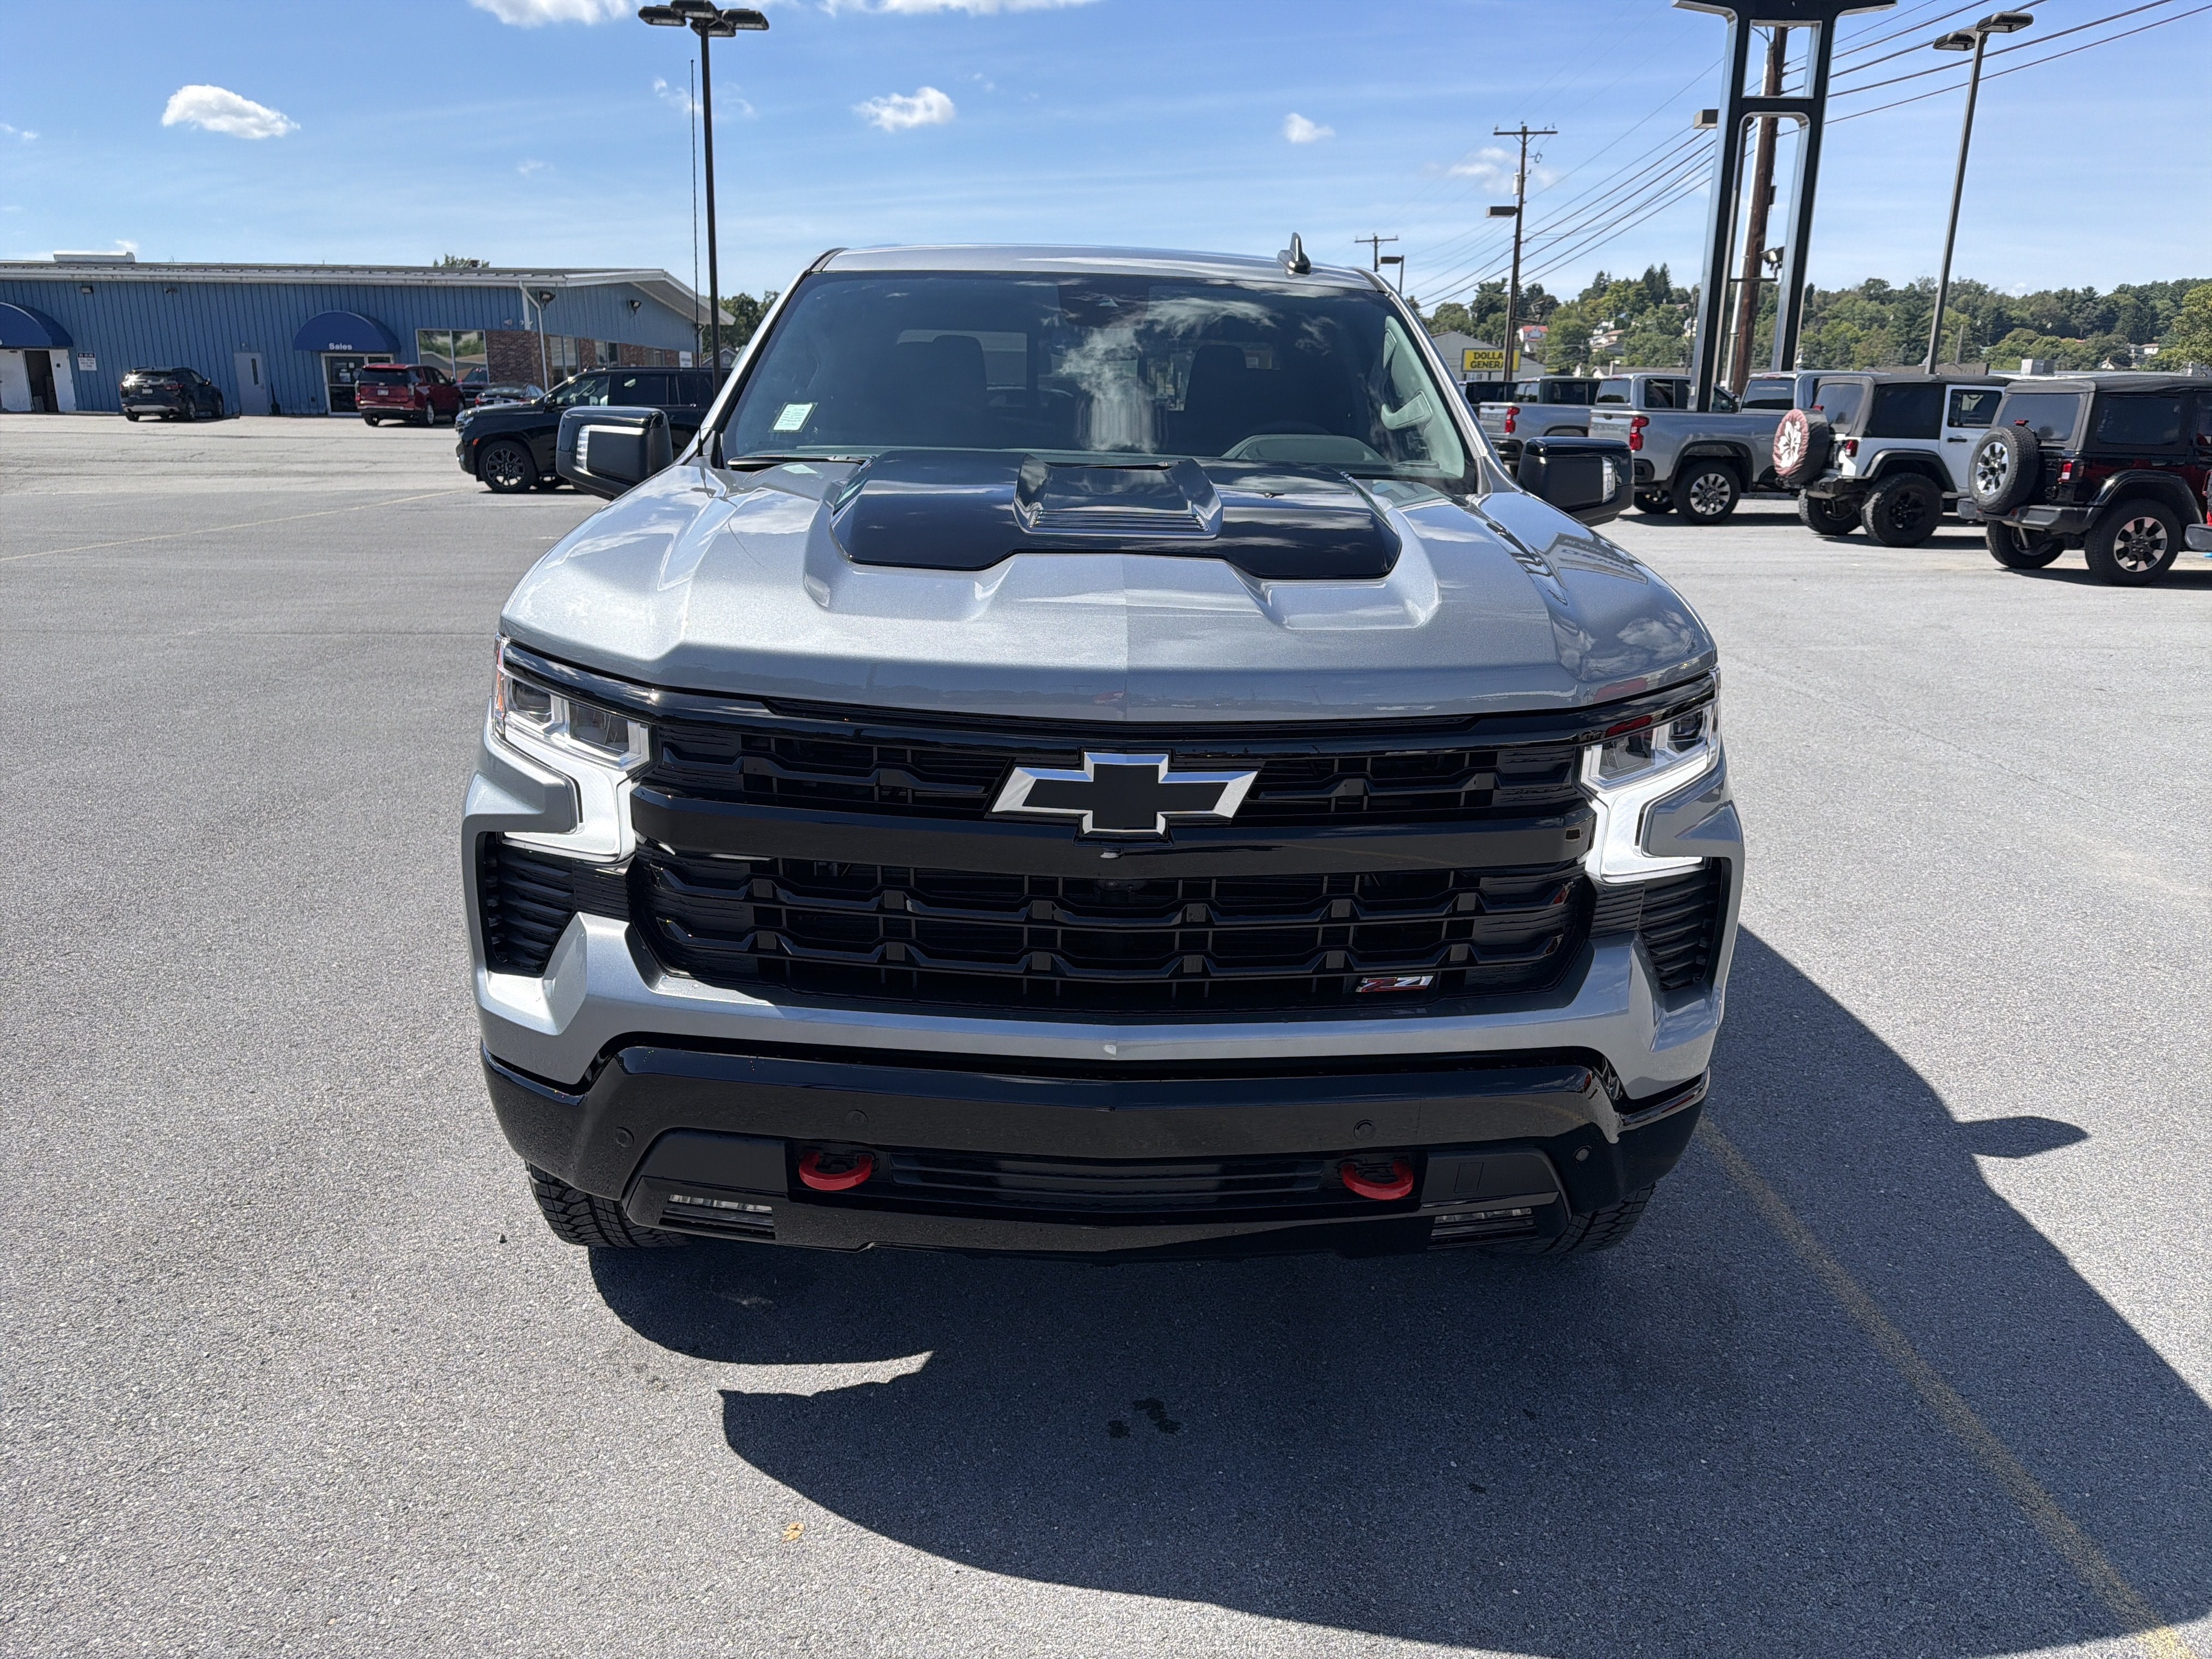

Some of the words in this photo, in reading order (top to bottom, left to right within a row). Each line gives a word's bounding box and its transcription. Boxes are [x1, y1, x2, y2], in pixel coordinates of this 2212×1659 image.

[1474, 352, 1504, 360] DOLLA
[1470, 360, 1504, 369] GENERA
[1356, 975, 1434, 993] Z71
